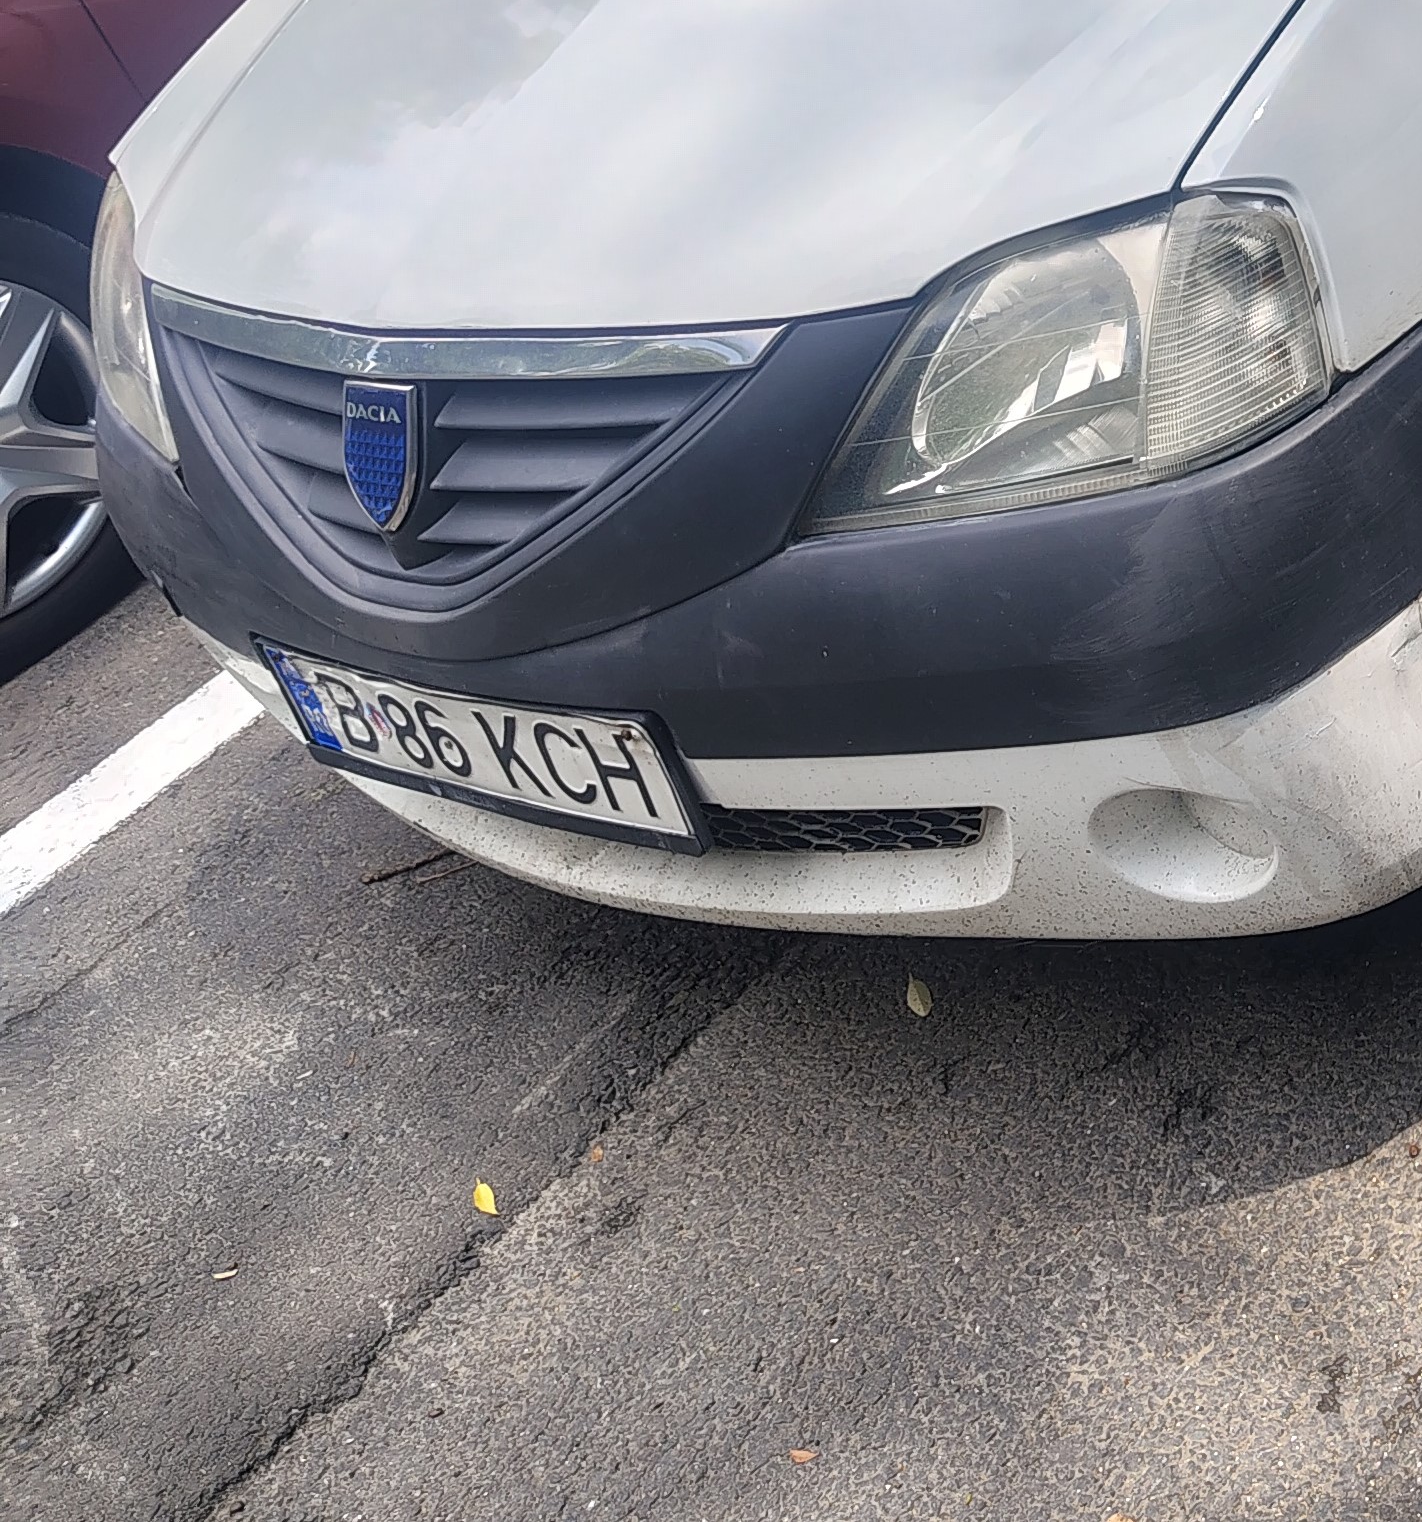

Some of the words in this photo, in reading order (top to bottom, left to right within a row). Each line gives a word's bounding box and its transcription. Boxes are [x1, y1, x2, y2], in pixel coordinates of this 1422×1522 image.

[346, 401, 402, 425] DACIA
[313, 670, 380, 754] B
[377, 691, 473, 778] 86
[471, 710, 661, 819] KCH
